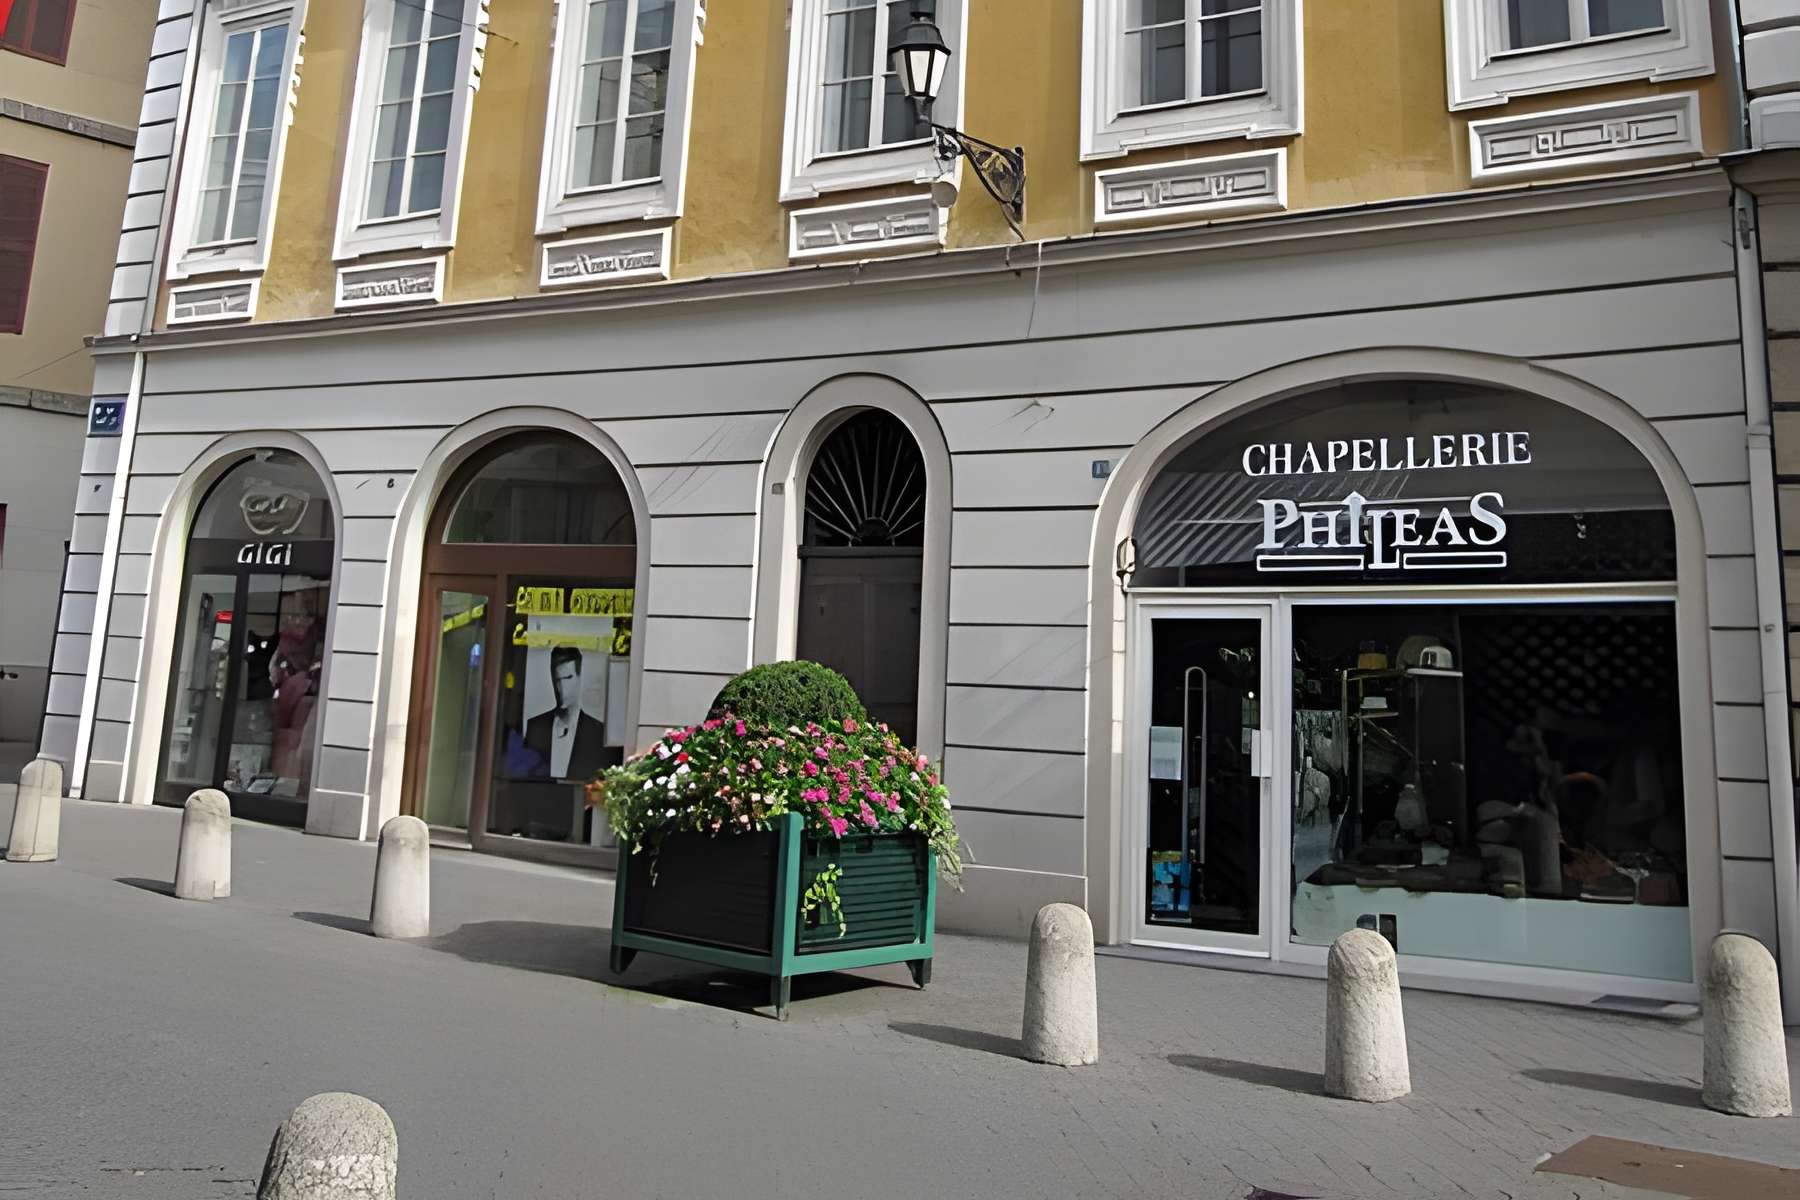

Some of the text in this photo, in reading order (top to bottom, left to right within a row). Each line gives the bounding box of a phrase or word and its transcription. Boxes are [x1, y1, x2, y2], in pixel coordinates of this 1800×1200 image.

[1242, 431, 1532, 476] CHAPELLERIE
[1254, 490, 1507, 570] PHILEAS
[237, 542, 292, 566] GIGI
